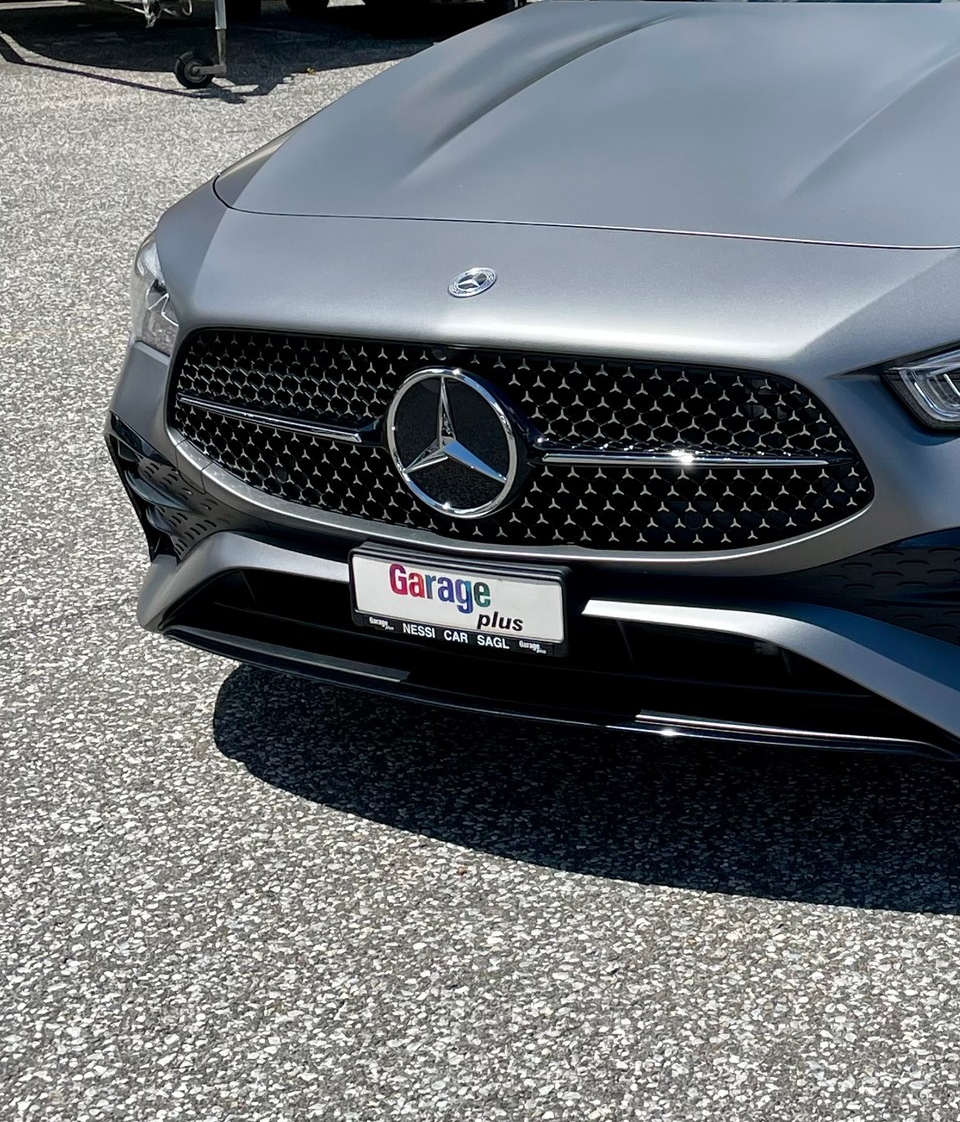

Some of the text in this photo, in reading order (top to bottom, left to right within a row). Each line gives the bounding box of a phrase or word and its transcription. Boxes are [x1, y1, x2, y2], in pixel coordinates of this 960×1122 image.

[389, 563, 491, 614] Garage
[369, 616, 389, 628] Garage
[476, 611, 524, 632] plus
[402, 623, 510, 650] NESSI CAR SAGL
[518, 640, 541, 652] Garage
